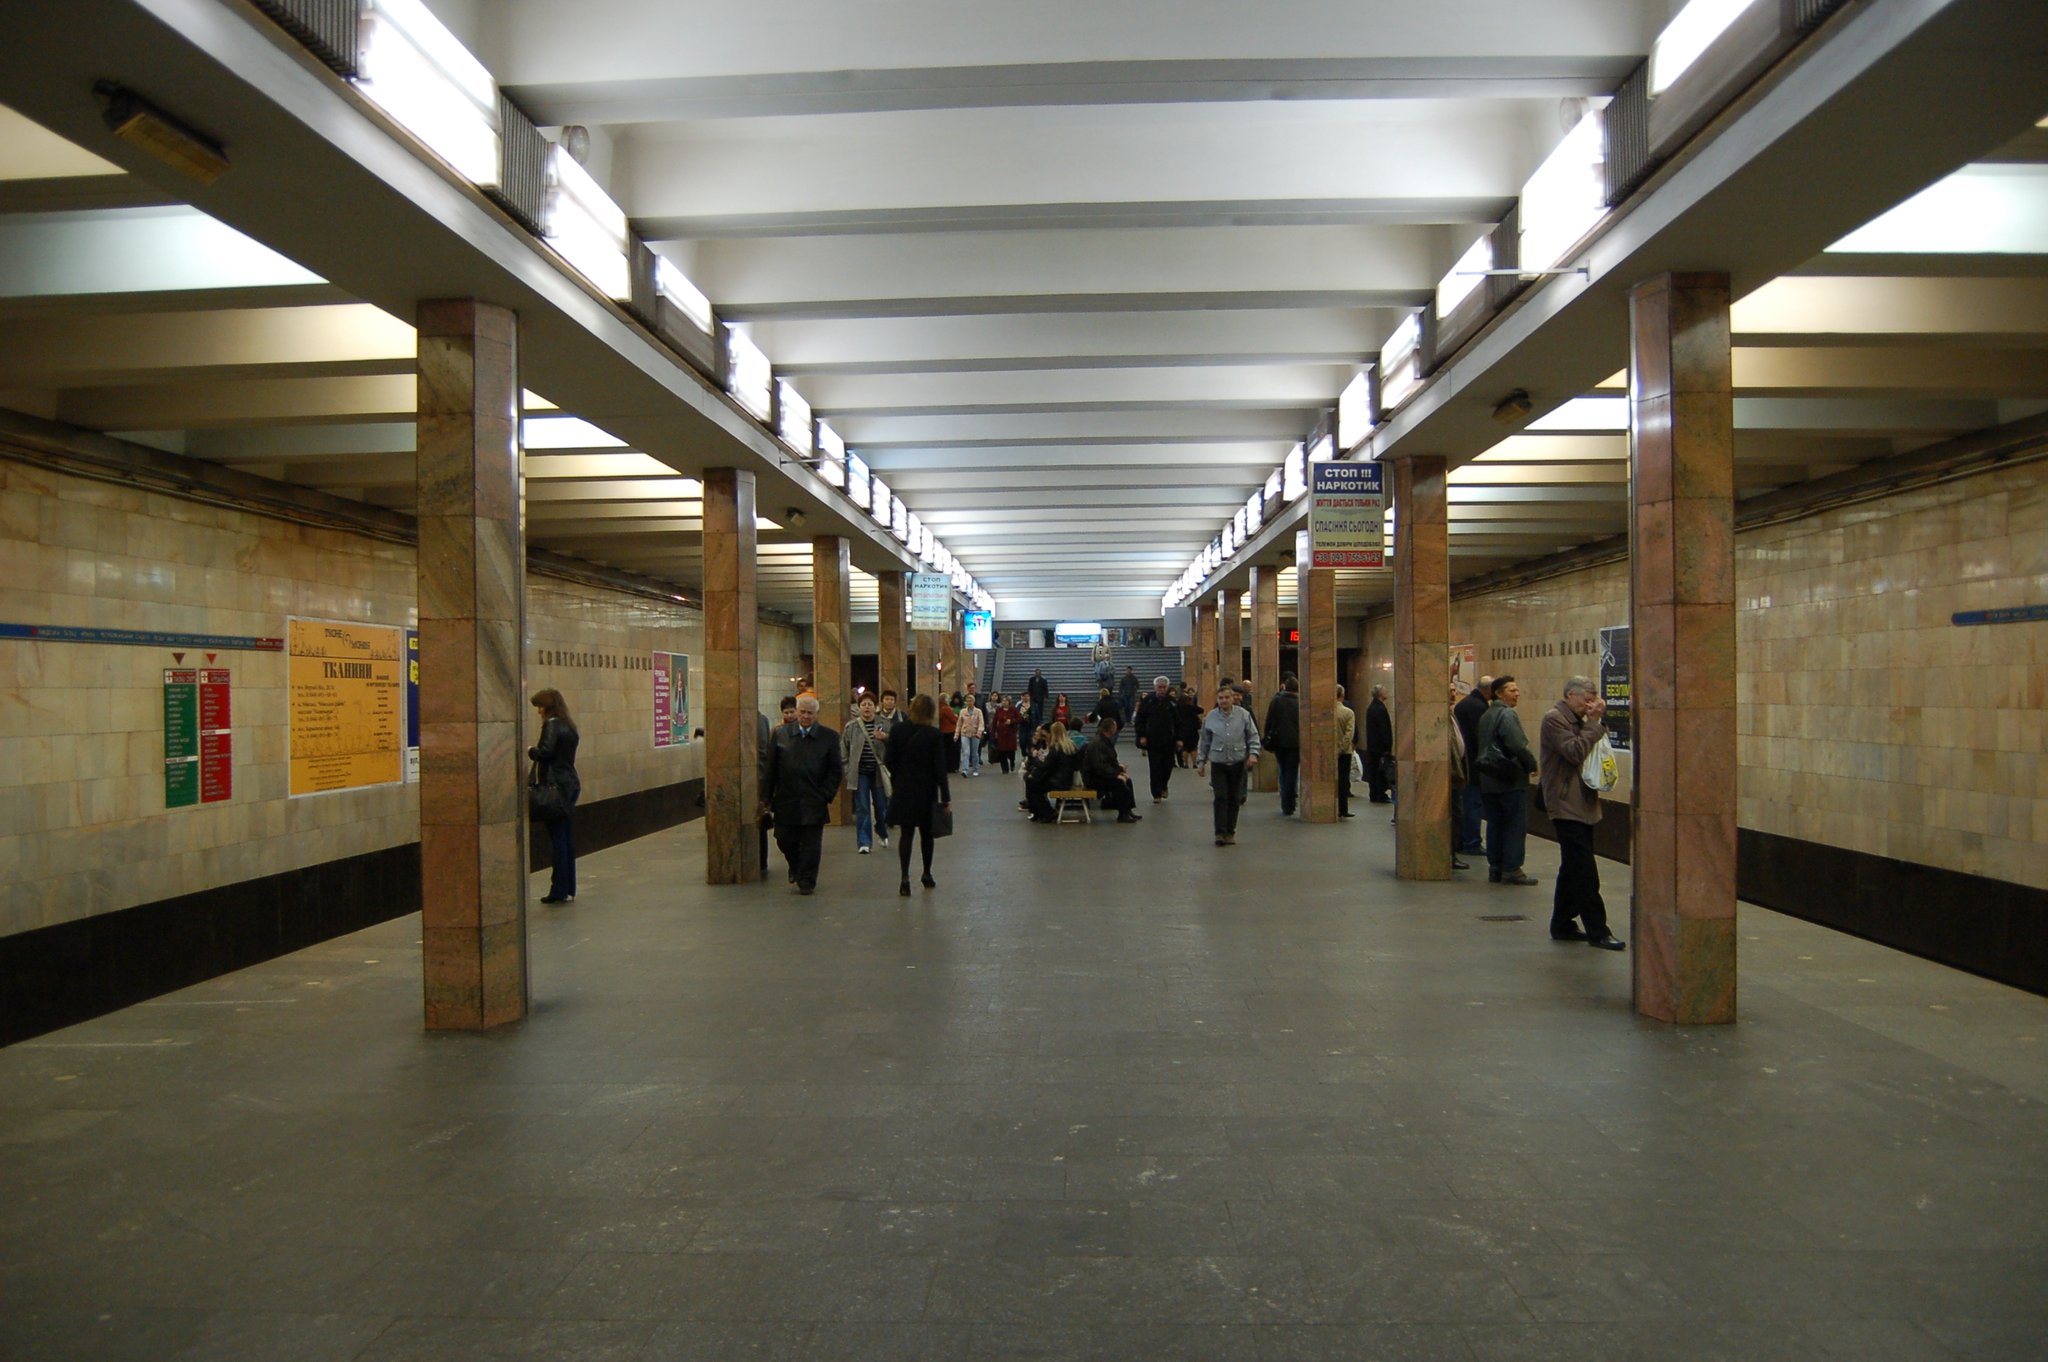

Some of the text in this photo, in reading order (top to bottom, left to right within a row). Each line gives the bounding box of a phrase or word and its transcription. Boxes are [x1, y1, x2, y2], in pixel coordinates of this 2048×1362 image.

[1325, 469, 1371, 477] СТОП !!!
[1317, 482, 1379, 490] НАРКОТИК
[1315, 521, 1380, 534] СПАСІННЯ СЬОГОДНІ
[1492, 643, 1553, 660] КОНТРАКТОВА
[1561, 639, 1597, 656] ПЛОЩА
[538, 650, 617, 669] КОНТРАКТОВА
[323, 661, 372, 679] ТКАНИНИ
